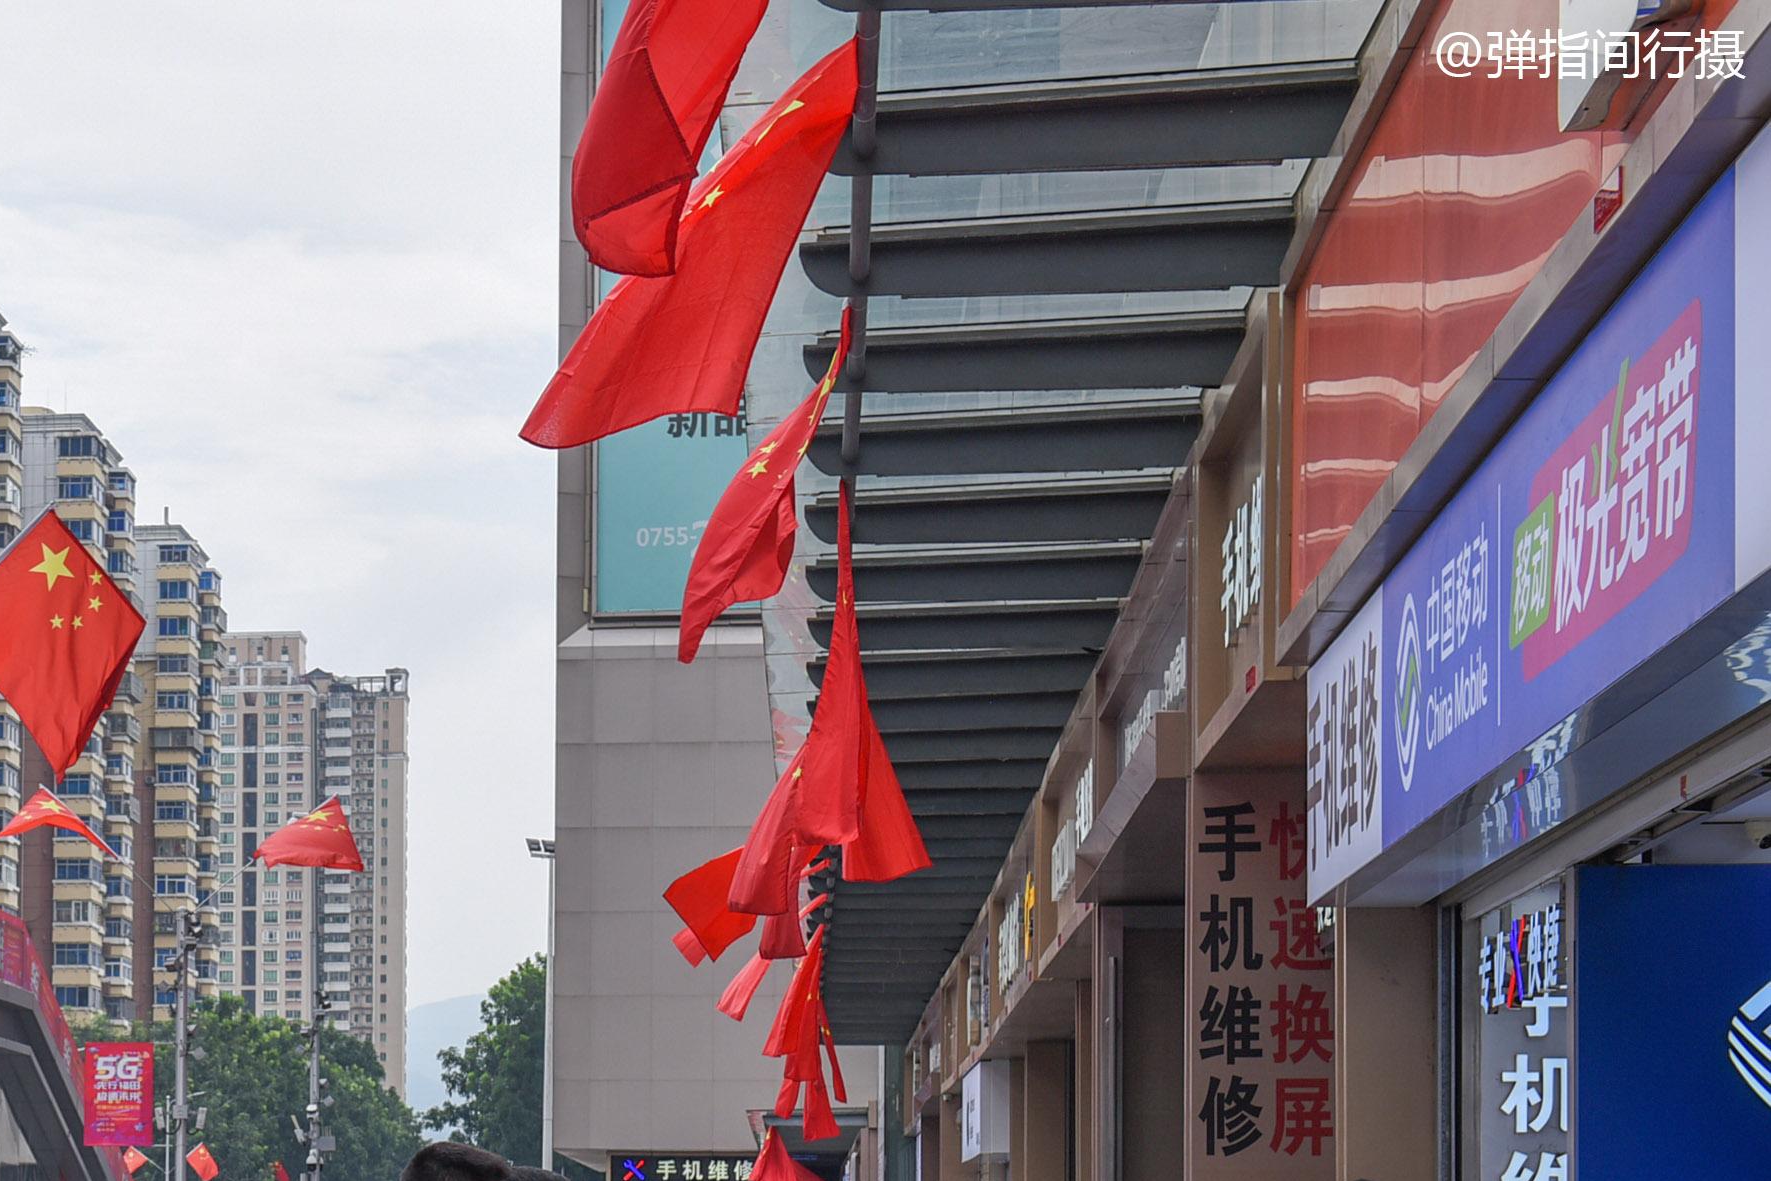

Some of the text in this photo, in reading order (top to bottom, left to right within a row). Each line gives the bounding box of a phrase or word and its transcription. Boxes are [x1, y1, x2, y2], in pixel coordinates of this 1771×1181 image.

[1426, 523, 1488, 674] 中国移动
[1514, 511, 1550, 636] 移动
[1307, 631, 1378, 873] 手机维修
[1425, 645, 1488, 751] China Mobile
[1198, 802, 1263, 1157] 手机维修
[94, 1056, 140, 1080] 5G
[656, 1159, 754, 1181] 手机维修
